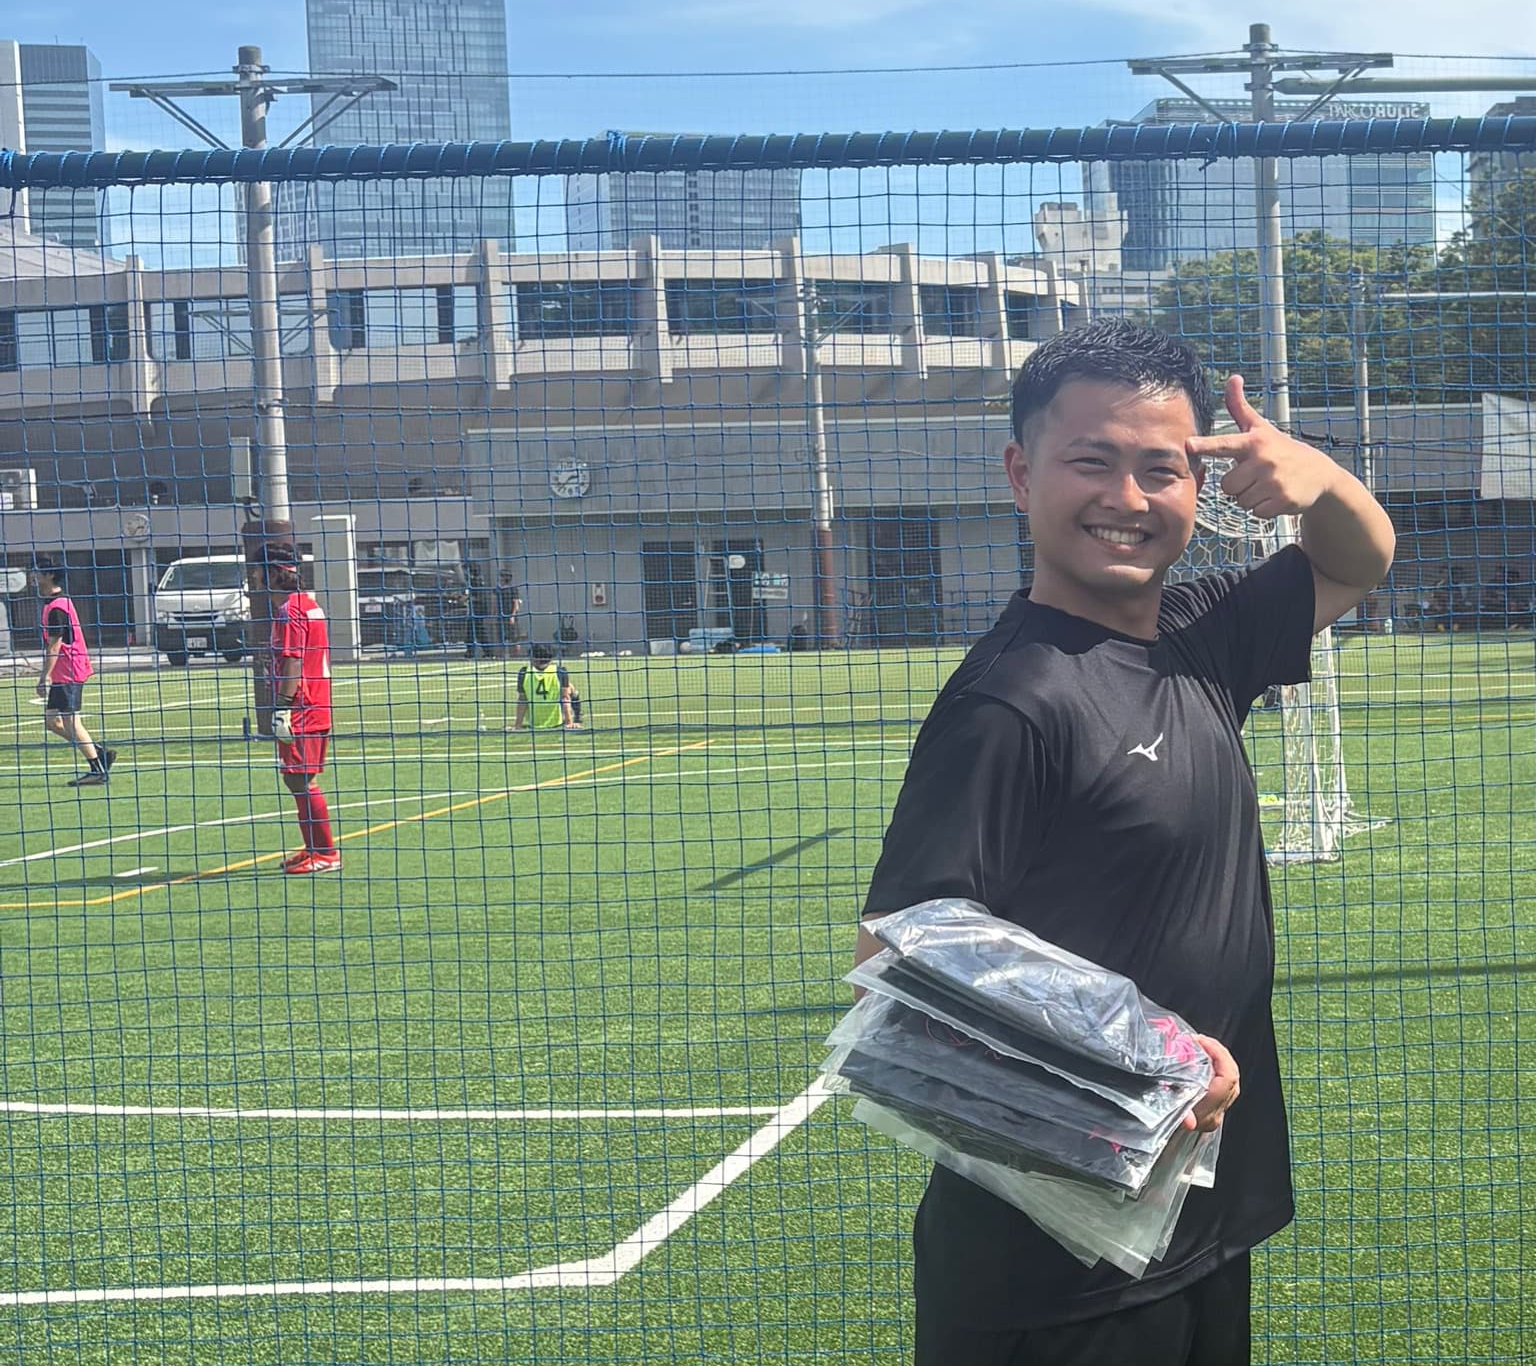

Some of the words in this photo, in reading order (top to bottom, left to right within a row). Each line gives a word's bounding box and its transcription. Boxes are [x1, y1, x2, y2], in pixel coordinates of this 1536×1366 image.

[1329, 103, 1374, 118] PARCO
[1375, 104, 1420, 118] HULIC
[535, 678, 549, 701] 4
